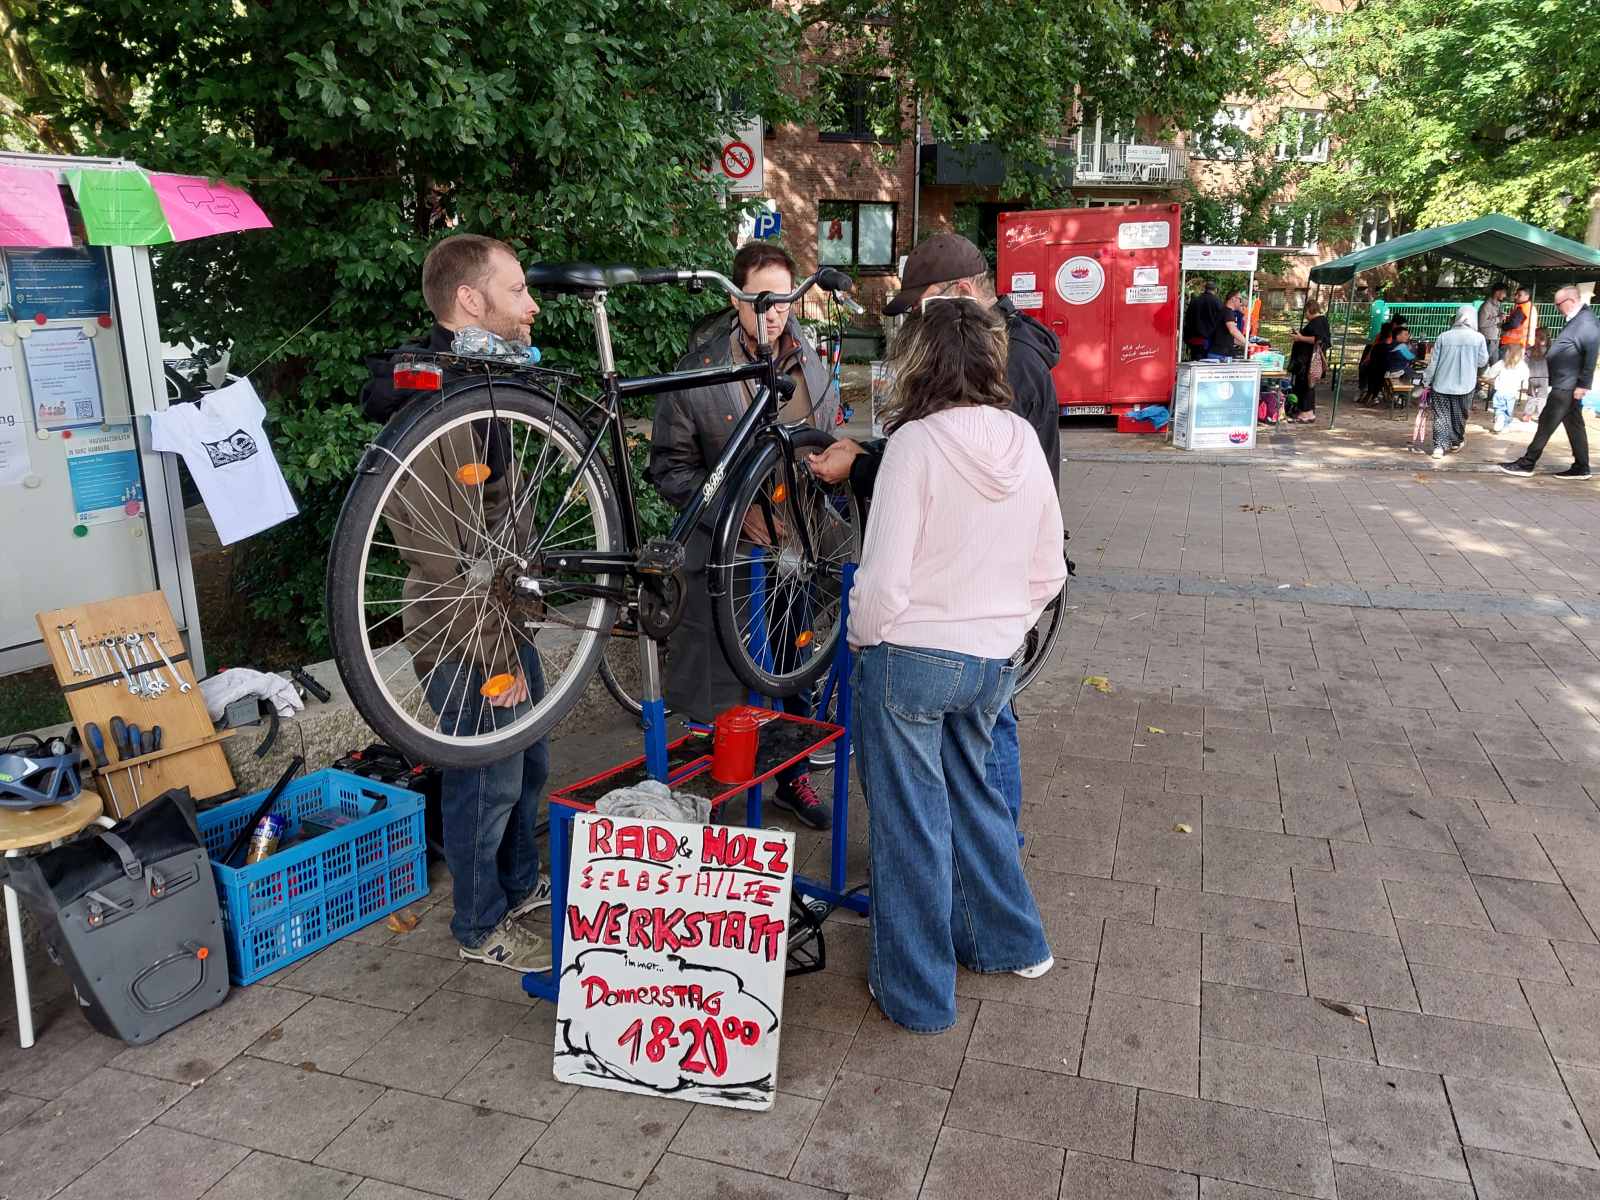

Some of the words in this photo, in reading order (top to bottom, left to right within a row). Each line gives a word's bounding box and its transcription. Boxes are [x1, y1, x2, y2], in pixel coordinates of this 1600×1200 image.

[760, 214, 775, 236] P
[588, 818, 677, 862] RAD
[676, 836, 693, 858] &
[701, 826, 788, 874] HOLZ
[580, 865, 781, 907] SELBSTHILFE
[567, 901, 785, 963] WERKSTATT
